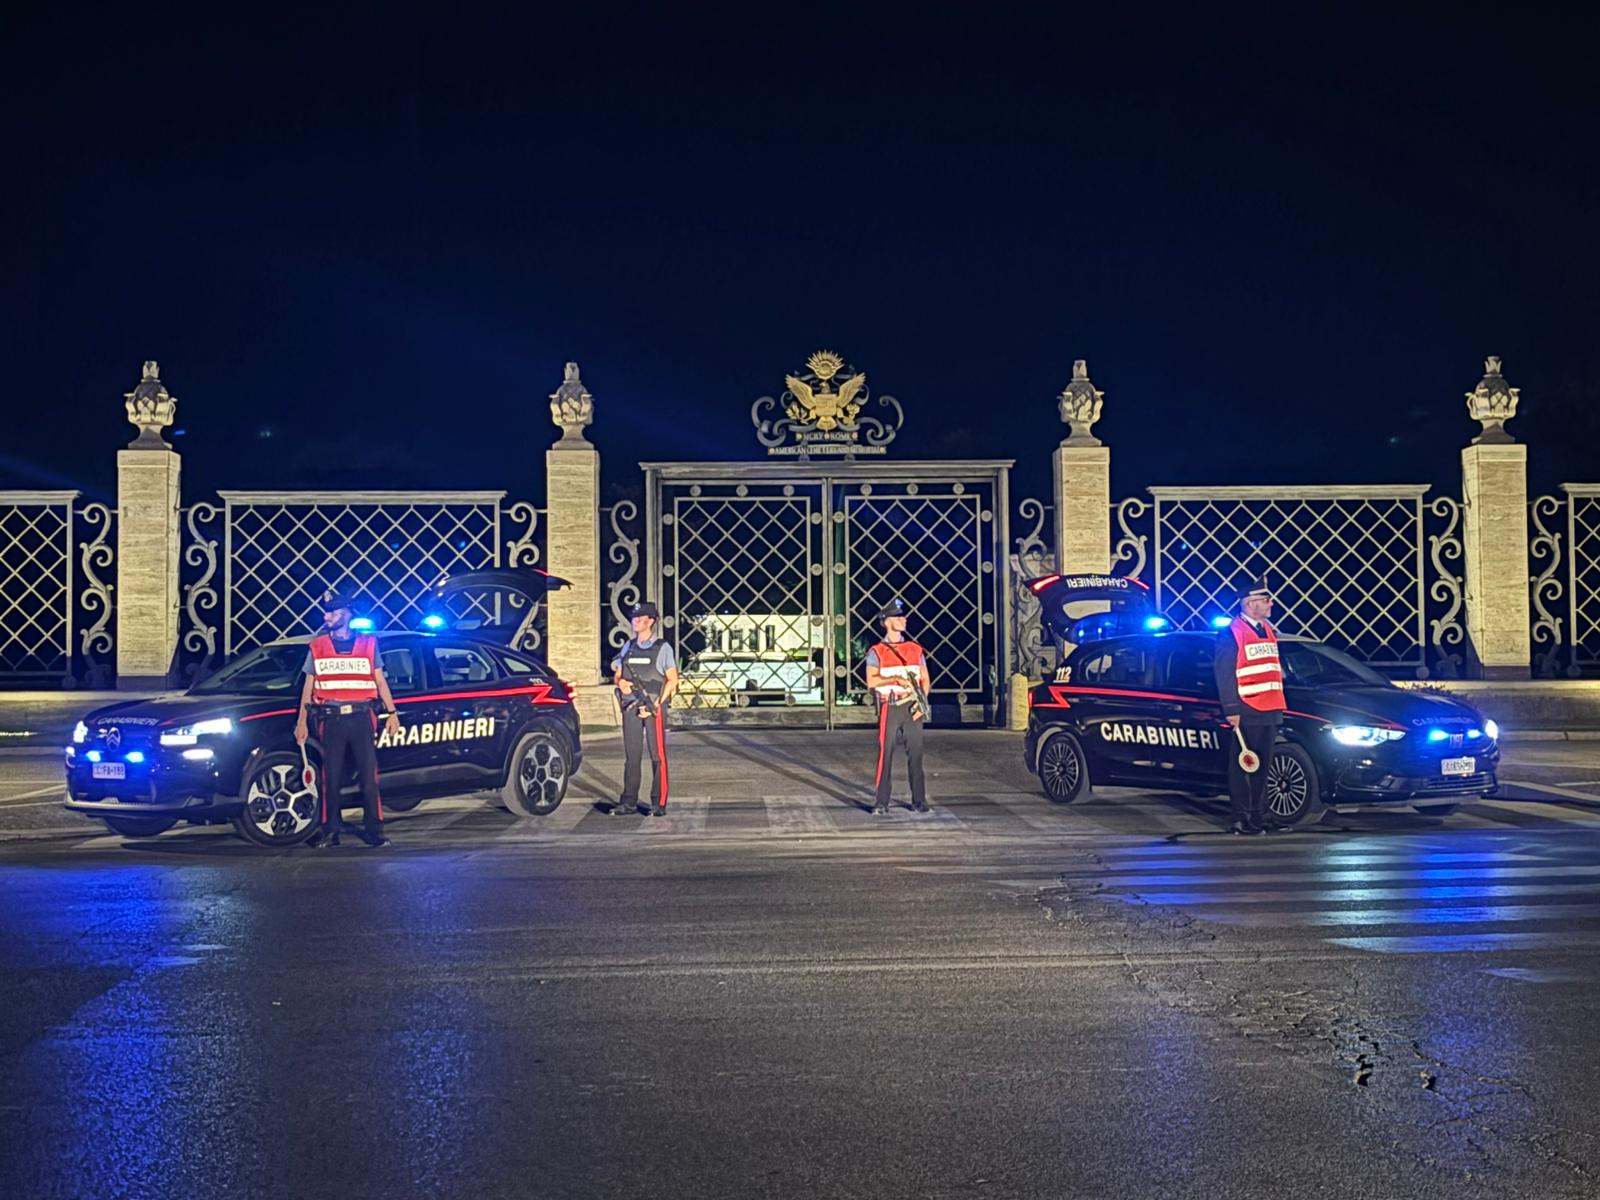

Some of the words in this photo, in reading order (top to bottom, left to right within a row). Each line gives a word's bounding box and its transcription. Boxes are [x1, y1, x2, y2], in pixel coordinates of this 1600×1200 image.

[1066, 577, 1128, 589] CARABINIERI
[1055, 666, 1072, 681] 112
[1100, 721, 1221, 750] CARABINIERI
